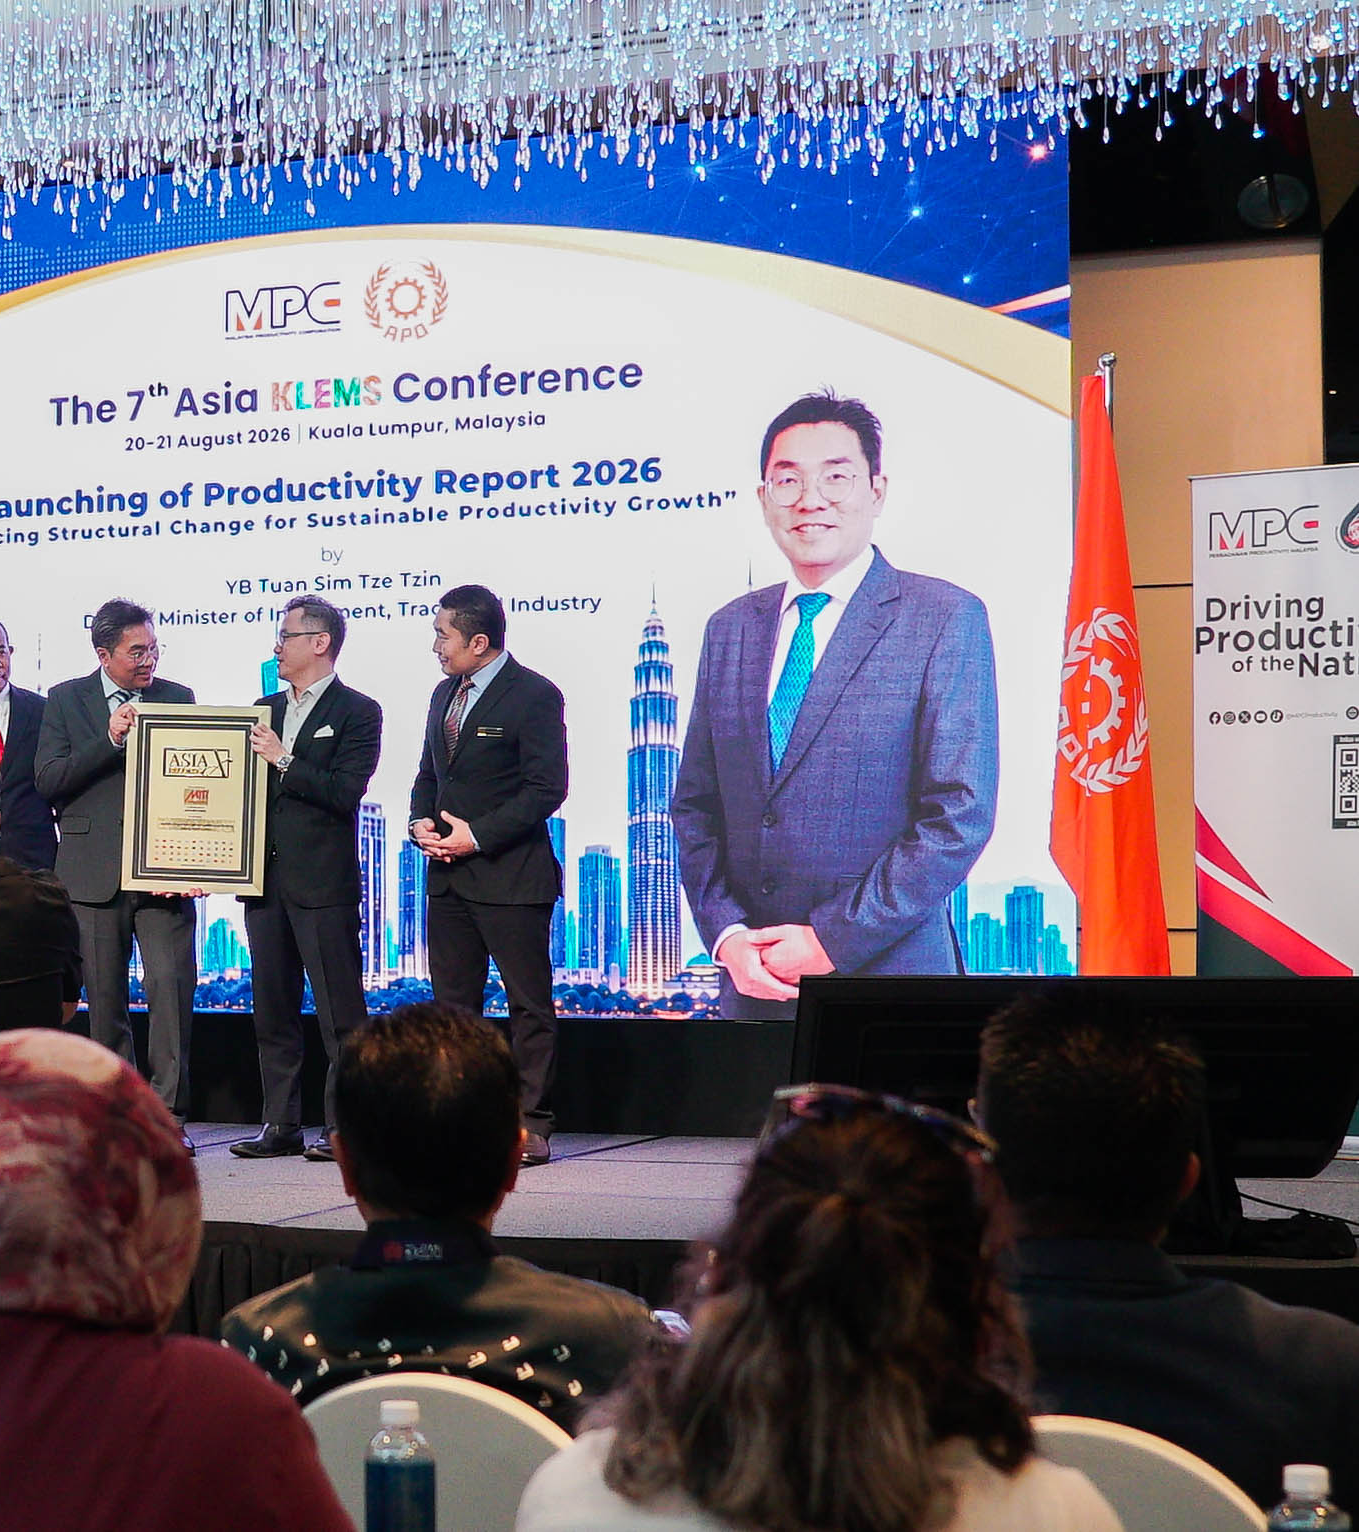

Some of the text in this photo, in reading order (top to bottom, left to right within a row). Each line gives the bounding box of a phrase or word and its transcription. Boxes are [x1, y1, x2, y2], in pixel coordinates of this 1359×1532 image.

[225, 281, 341, 333] MPC
[383, 323, 429, 343] APO
[49, 363, 643, 427] The 7th Asia KLEMS Conference
[124, 410, 546, 452] 20-21 August 2026 Kuala Lumpur, Malaysia
[159, 482, 194, 509] of
[203, 468, 423, 507] Productivity
[434, 463, 561, 498] Report
[572, 456, 663, 488] 2026
[47, 520, 161, 542] Structural
[169, 517, 255, 538] Change
[264, 513, 299, 531] for
[306, 504, 450, 529] Sustainable
[458, 496, 618, 522] Productivity
[1208, 504, 1320, 552] MPC
[320, 546, 344, 566] by
[225, 569, 441, 595] YB Tuan Sim Tze Tzin
[159, 608, 238, 627] Minister
[243, 607, 264, 624] of
[510, 595, 603, 615] Industry
[1205, 592, 1325, 623] Driving
[1194, 616, 1359, 655] Producti
[1231, 651, 1359, 678] of the Nat
